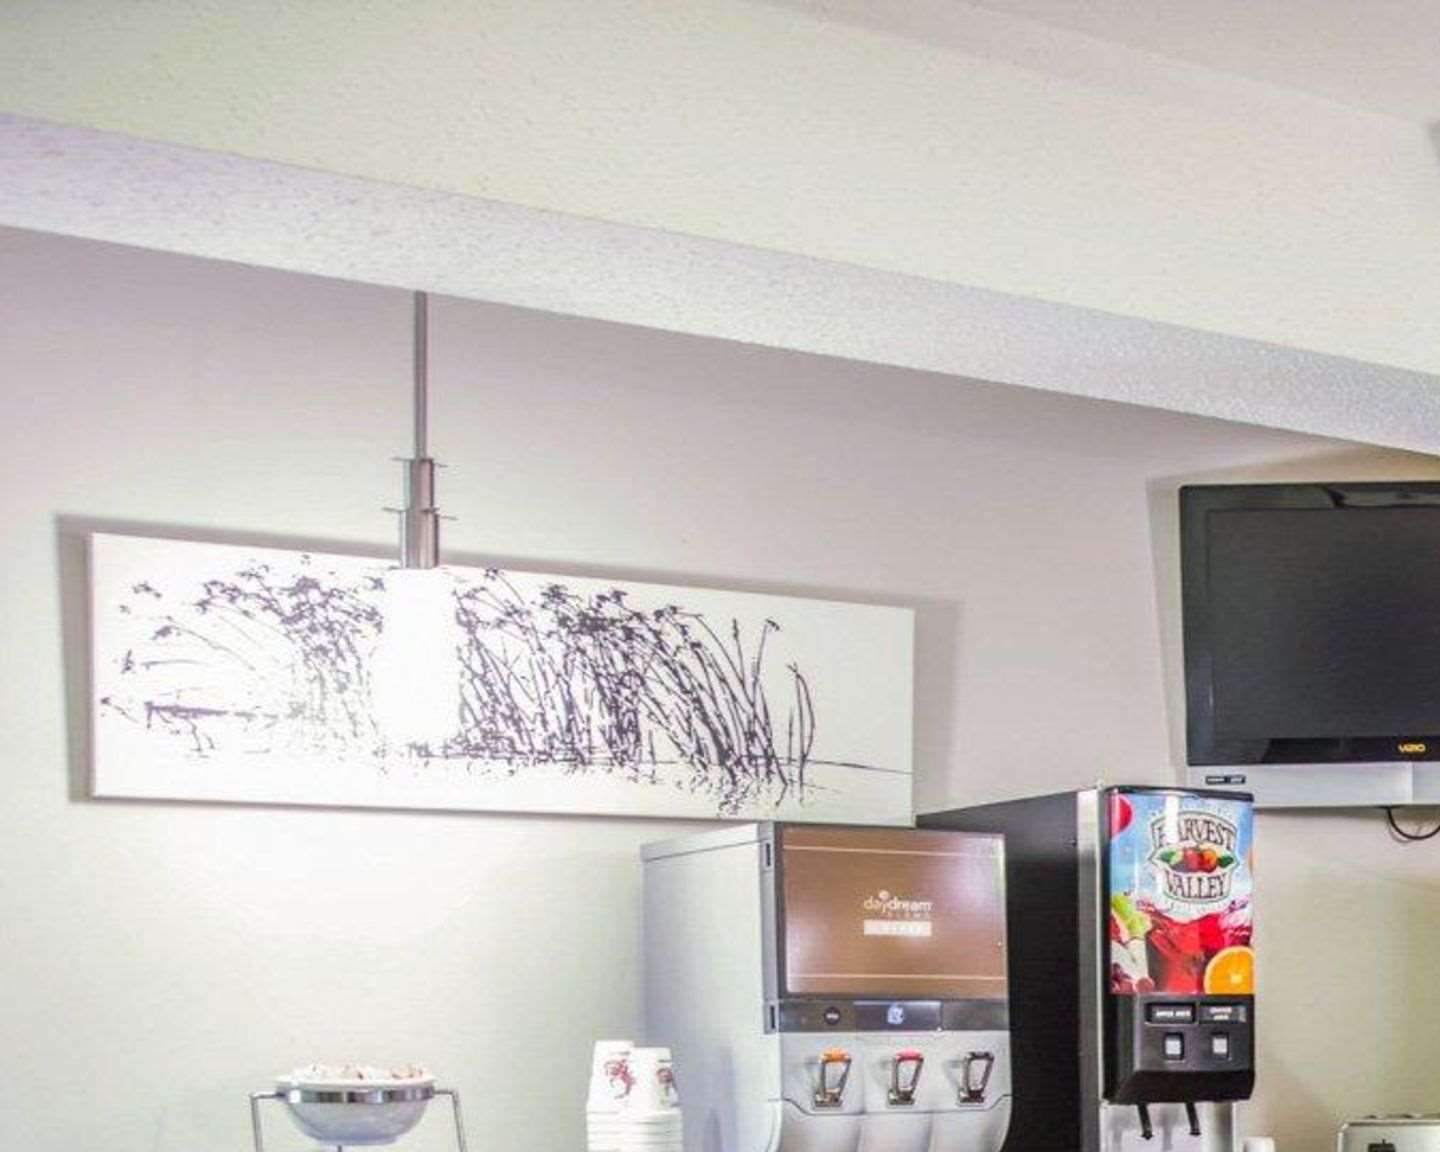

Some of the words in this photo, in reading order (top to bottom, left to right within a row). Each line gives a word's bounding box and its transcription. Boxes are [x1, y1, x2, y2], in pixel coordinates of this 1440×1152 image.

[1397, 743, 1426, 754] VIZIO
[1164, 870, 1227, 898] VALLEY
[864, 895, 934, 913] daydream
